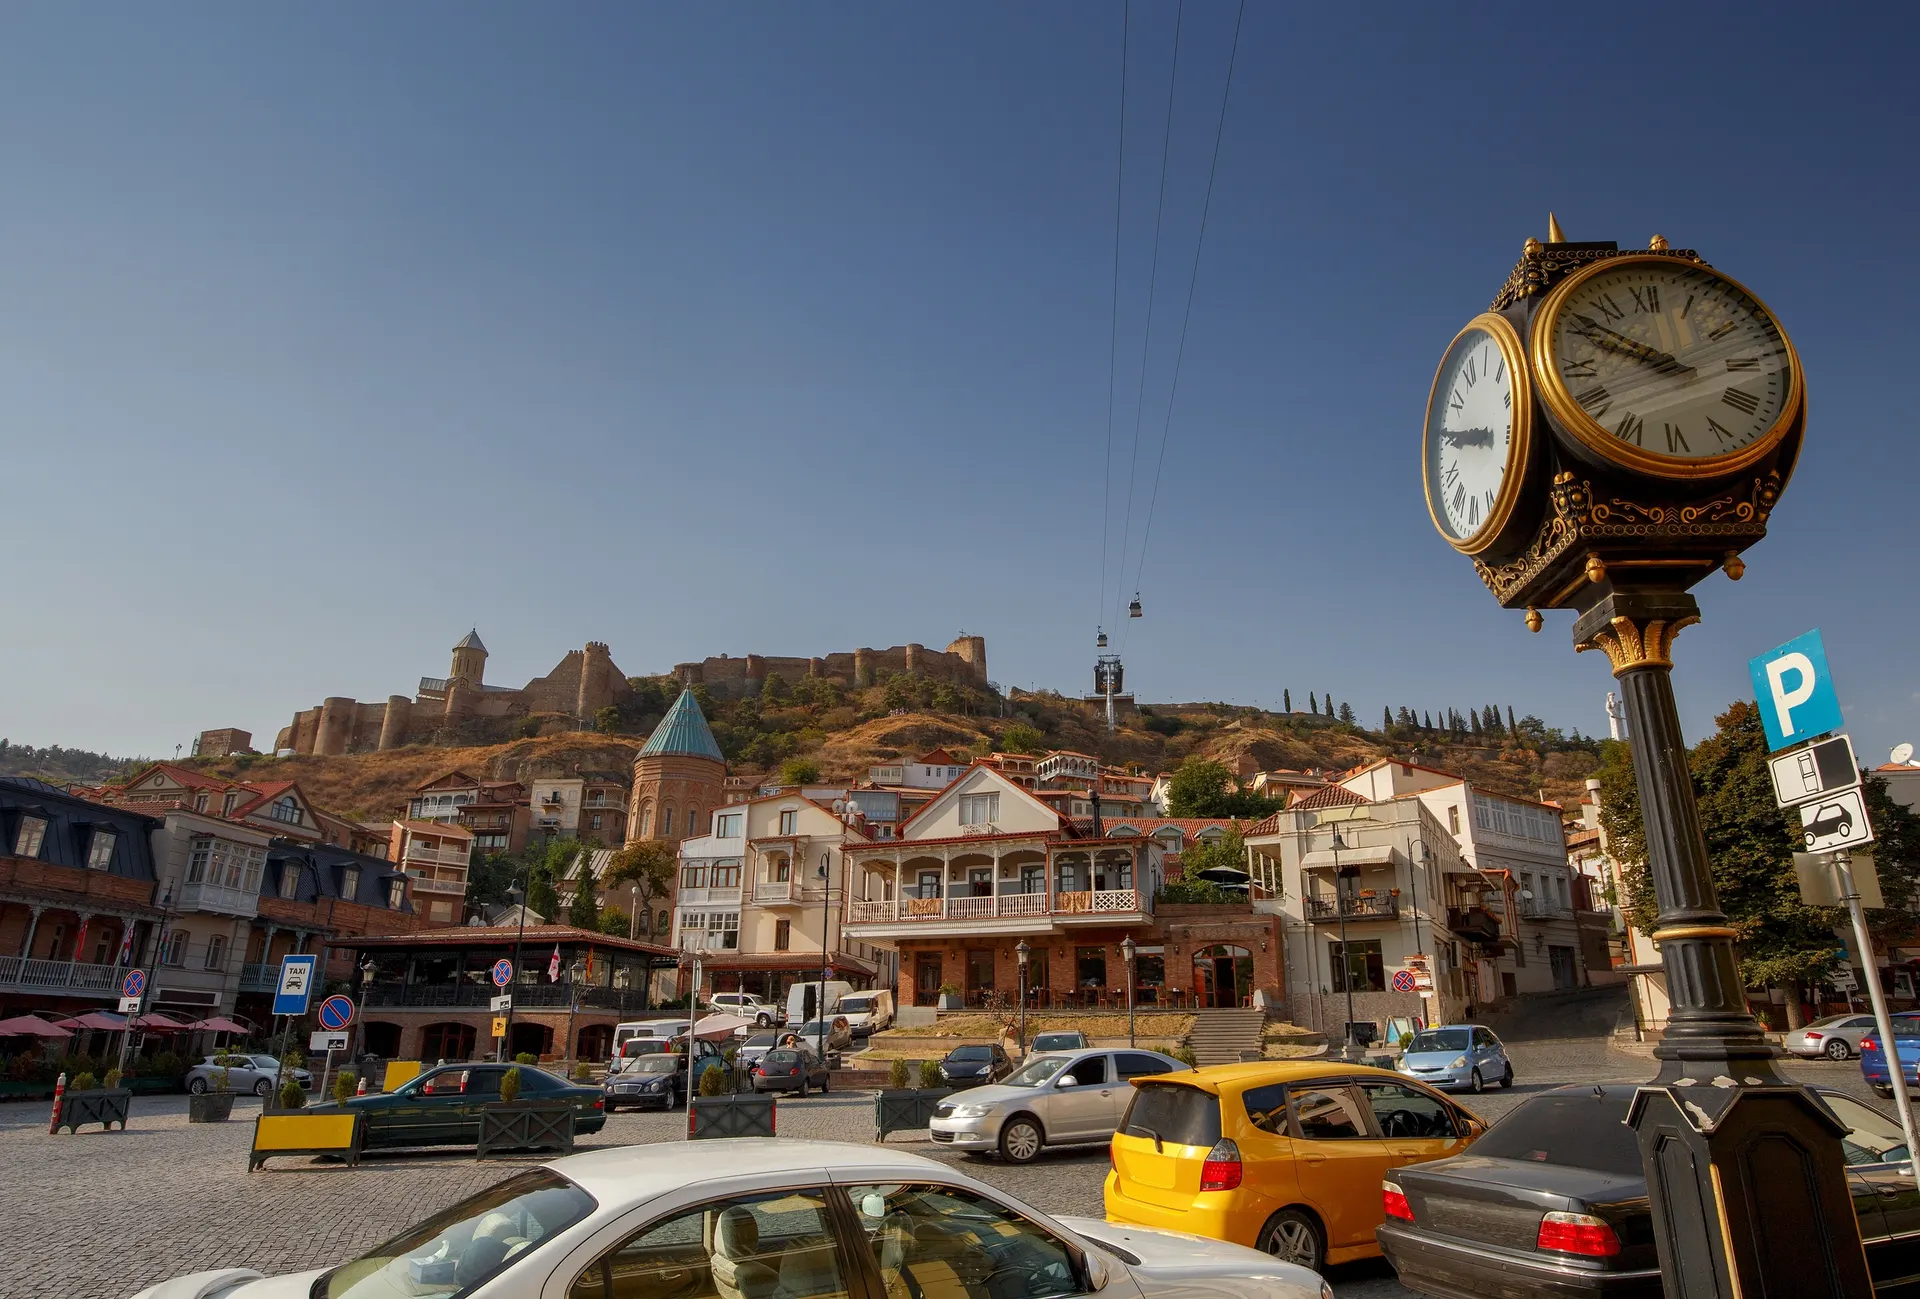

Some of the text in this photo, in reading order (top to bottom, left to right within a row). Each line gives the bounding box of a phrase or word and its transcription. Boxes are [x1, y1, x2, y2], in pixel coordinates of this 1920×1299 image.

[1588, 293, 1625, 325] XI
[1628, 286, 1660, 314] XII
[1680, 295, 1695, 320] I
[1708, 321, 1739, 341] II
[1561, 358, 1598, 377] IX
[1725, 358, 1761, 372] III
[1721, 387, 1760, 416] IIII
[1664, 423, 1691, 453] VI
[1766, 652, 1815, 738] P
[289, 967, 306, 975] TAXI
